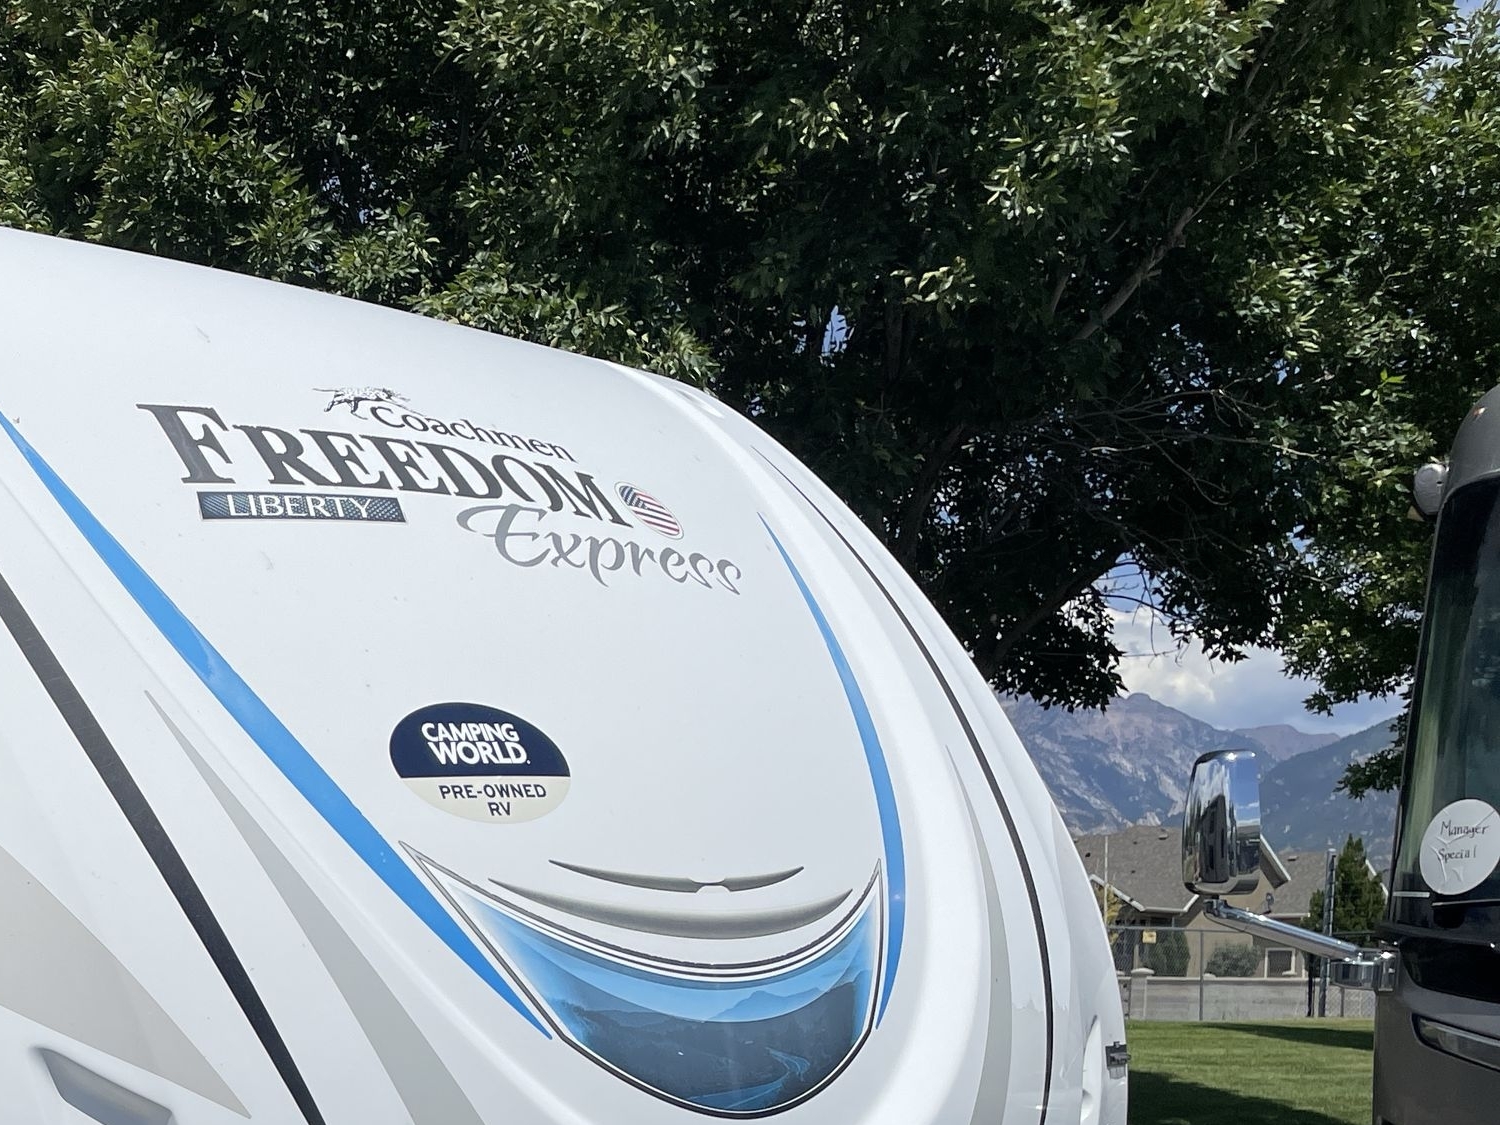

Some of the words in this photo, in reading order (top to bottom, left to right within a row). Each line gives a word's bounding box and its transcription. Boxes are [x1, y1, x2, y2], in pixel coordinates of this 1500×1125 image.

[371, 407, 576, 461] Coachmen
[226, 494, 377, 518] LIBERTY
[456, 504, 742, 595] Express
[421, 723, 520, 742] CAMPING
[438, 784, 547, 799] PRE-OWNED
[487, 802, 512, 816] RV
[1440, 820, 1489, 838] Manager
[1438, 844, 1477, 863] Special
